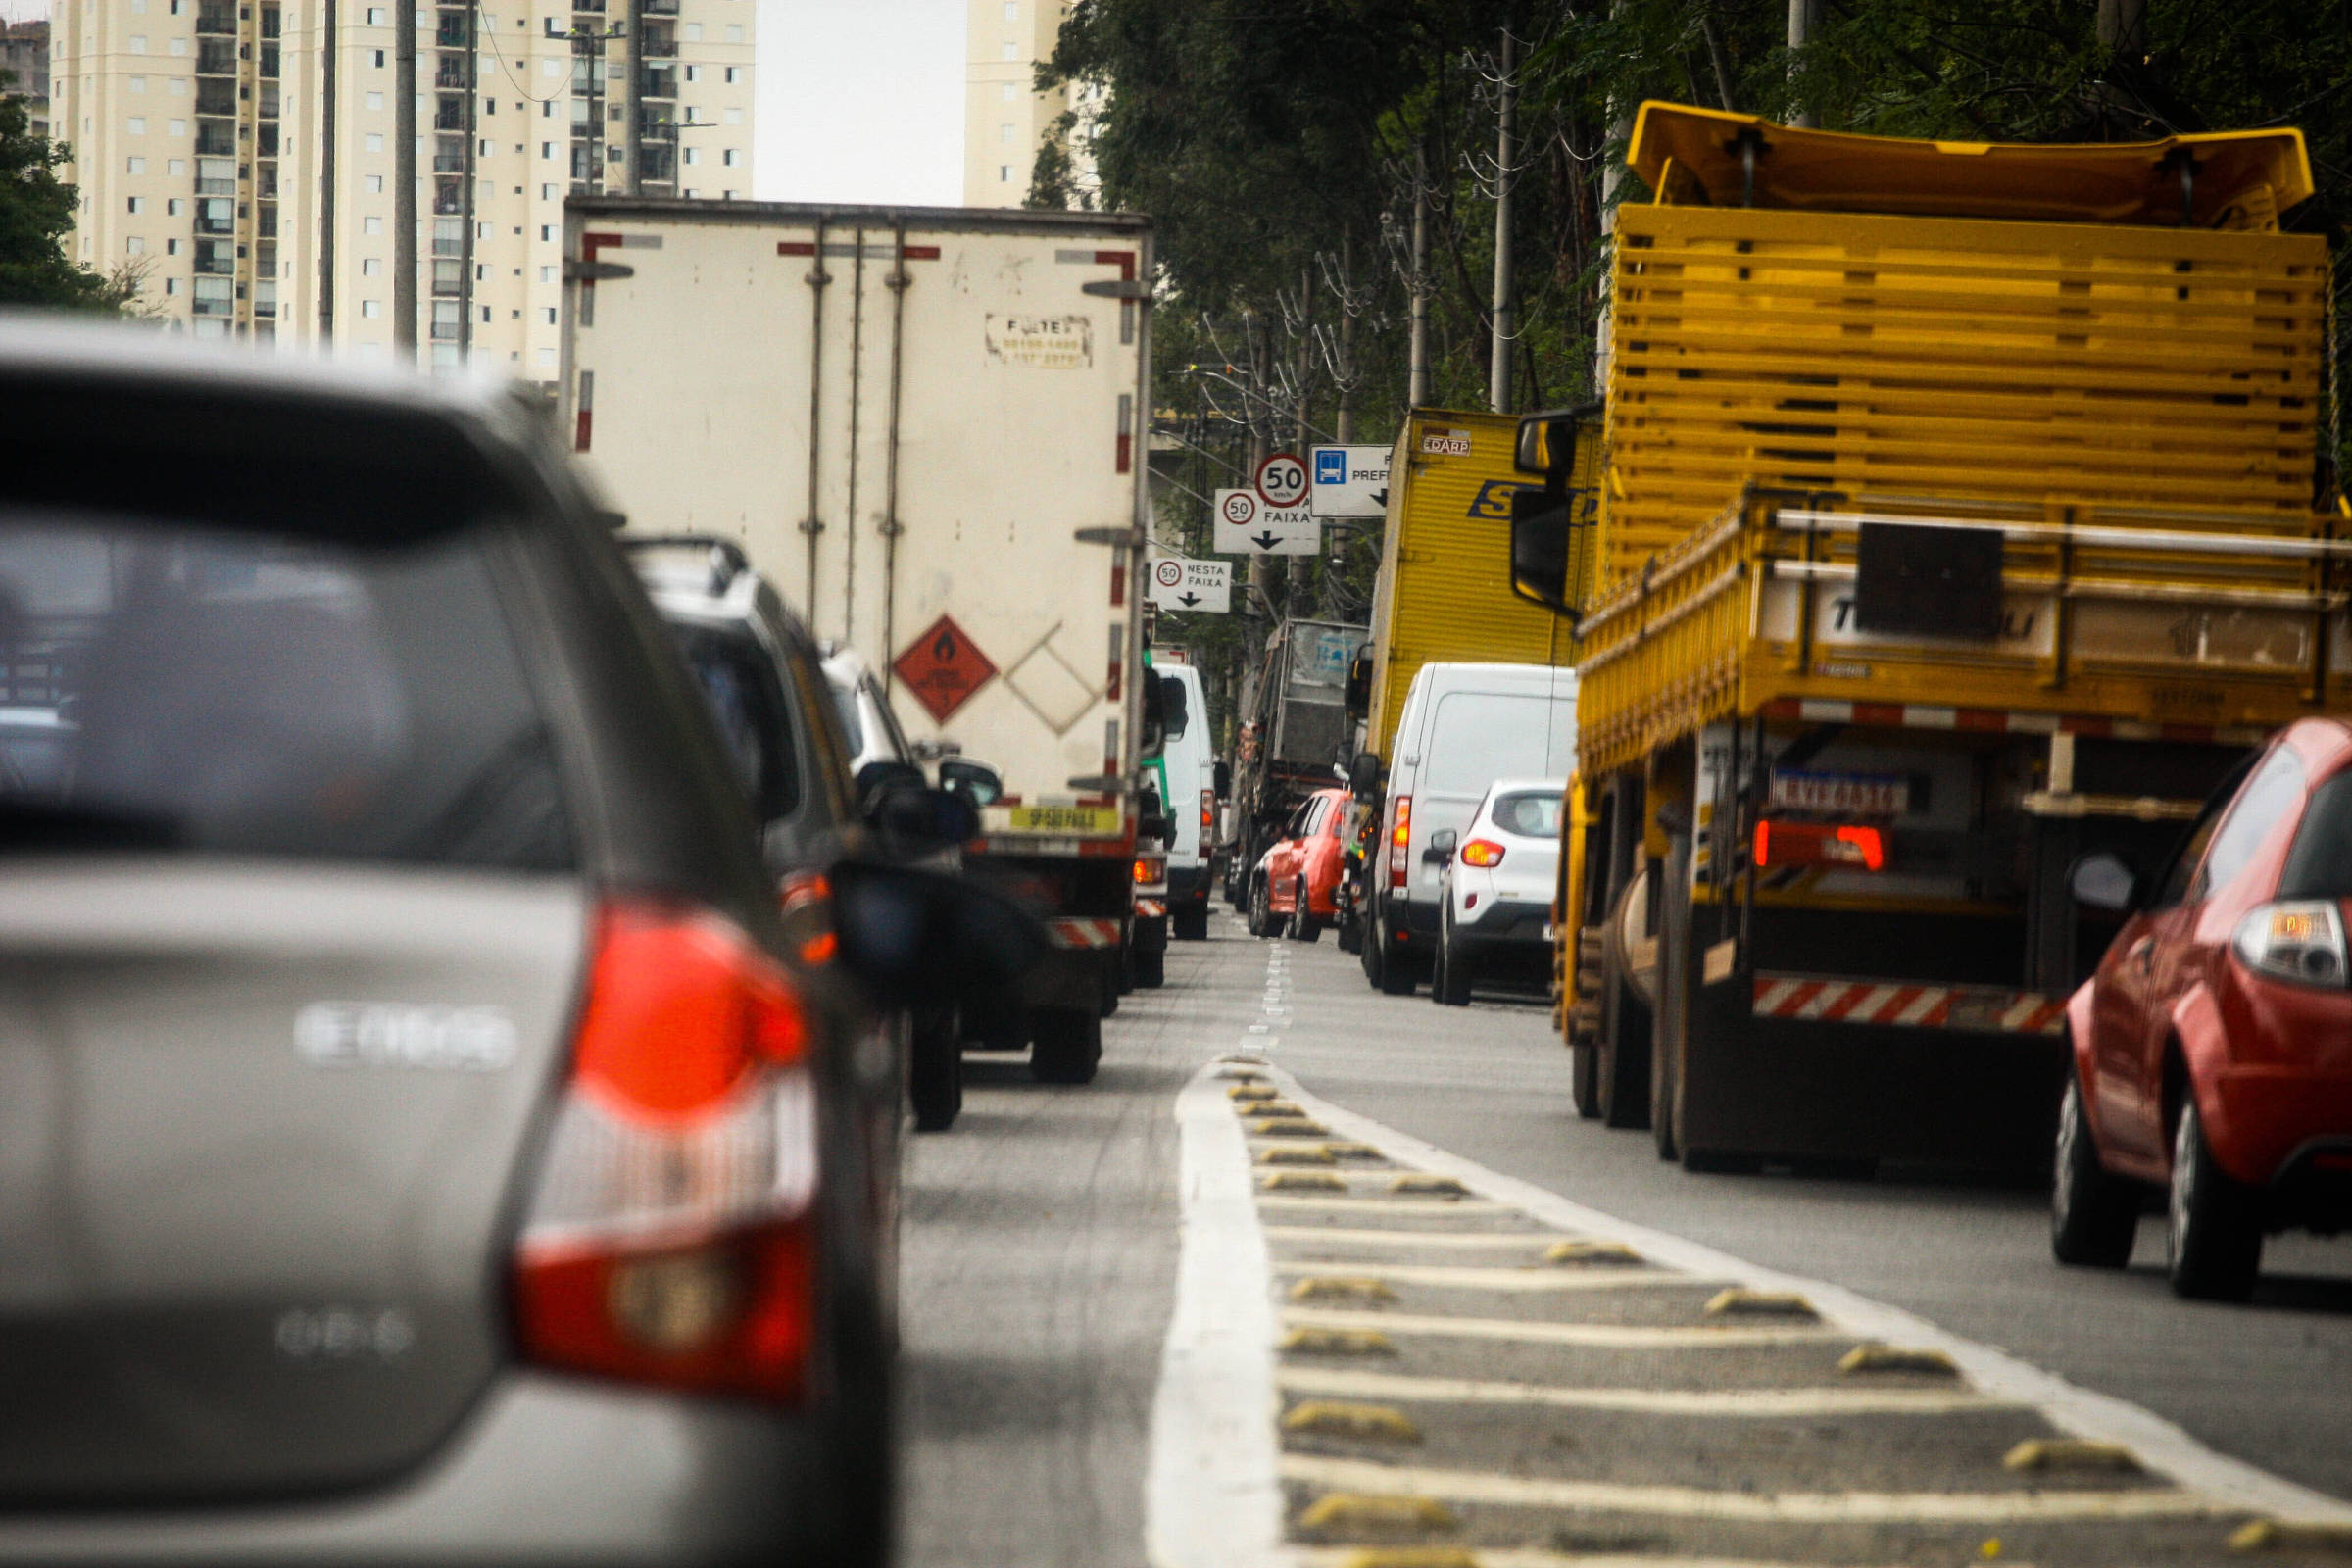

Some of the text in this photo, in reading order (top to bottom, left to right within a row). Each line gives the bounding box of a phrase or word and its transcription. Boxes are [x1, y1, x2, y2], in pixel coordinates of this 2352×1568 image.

[1266, 467, 1302, 489] 50
[1352, 470, 1389, 480] PREF
[1230, 502, 1248, 514] 50
[1264, 512, 1310, 523] FAIXA
[1161, 568, 1176, 578] 50
[1187, 565, 1224, 575] NESTA
[1188, 577, 1222, 587] FAIXA
